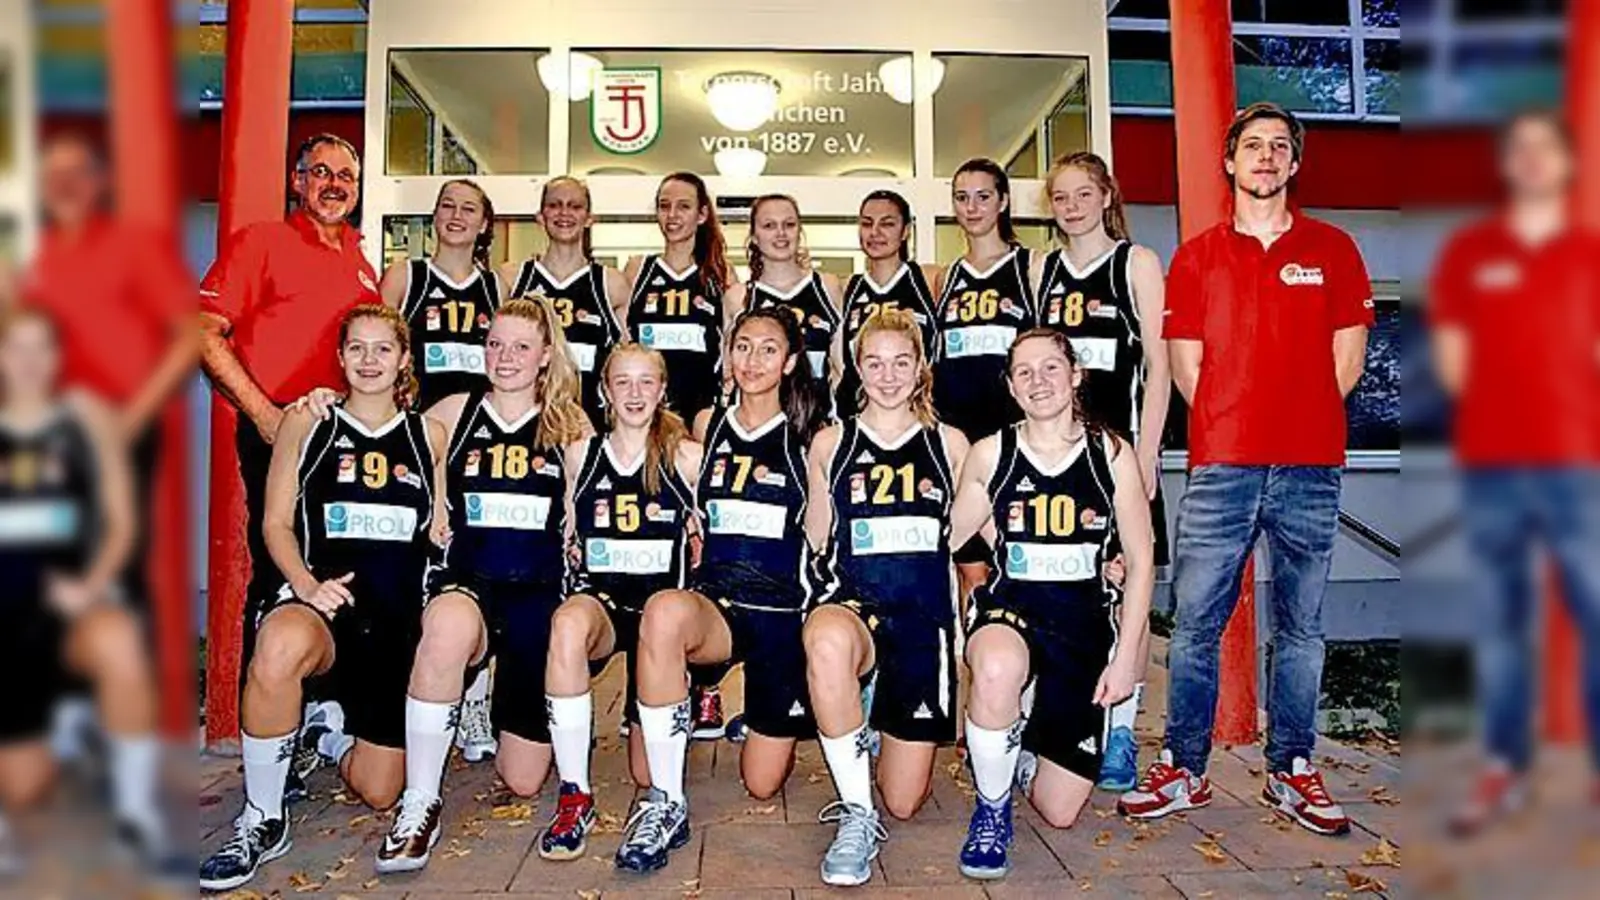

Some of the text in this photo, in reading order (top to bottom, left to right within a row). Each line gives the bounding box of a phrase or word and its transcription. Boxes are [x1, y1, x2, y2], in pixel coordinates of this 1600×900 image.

[839, 71, 884, 93] Jah
[700, 132, 872, 153] von 1887 e.V.
[442, 300, 475, 333] 17
[662, 288, 690, 316] 11
[960, 289, 999, 322] 36
[1064, 291, 1084, 327] 8
[362, 451, 388, 489] 9
[486, 443, 529, 479] 18
[731, 455, 753, 493] 7
[870, 462, 915, 504] 21
[615, 494, 640, 533] 5
[1028, 493, 1075, 537] 10
